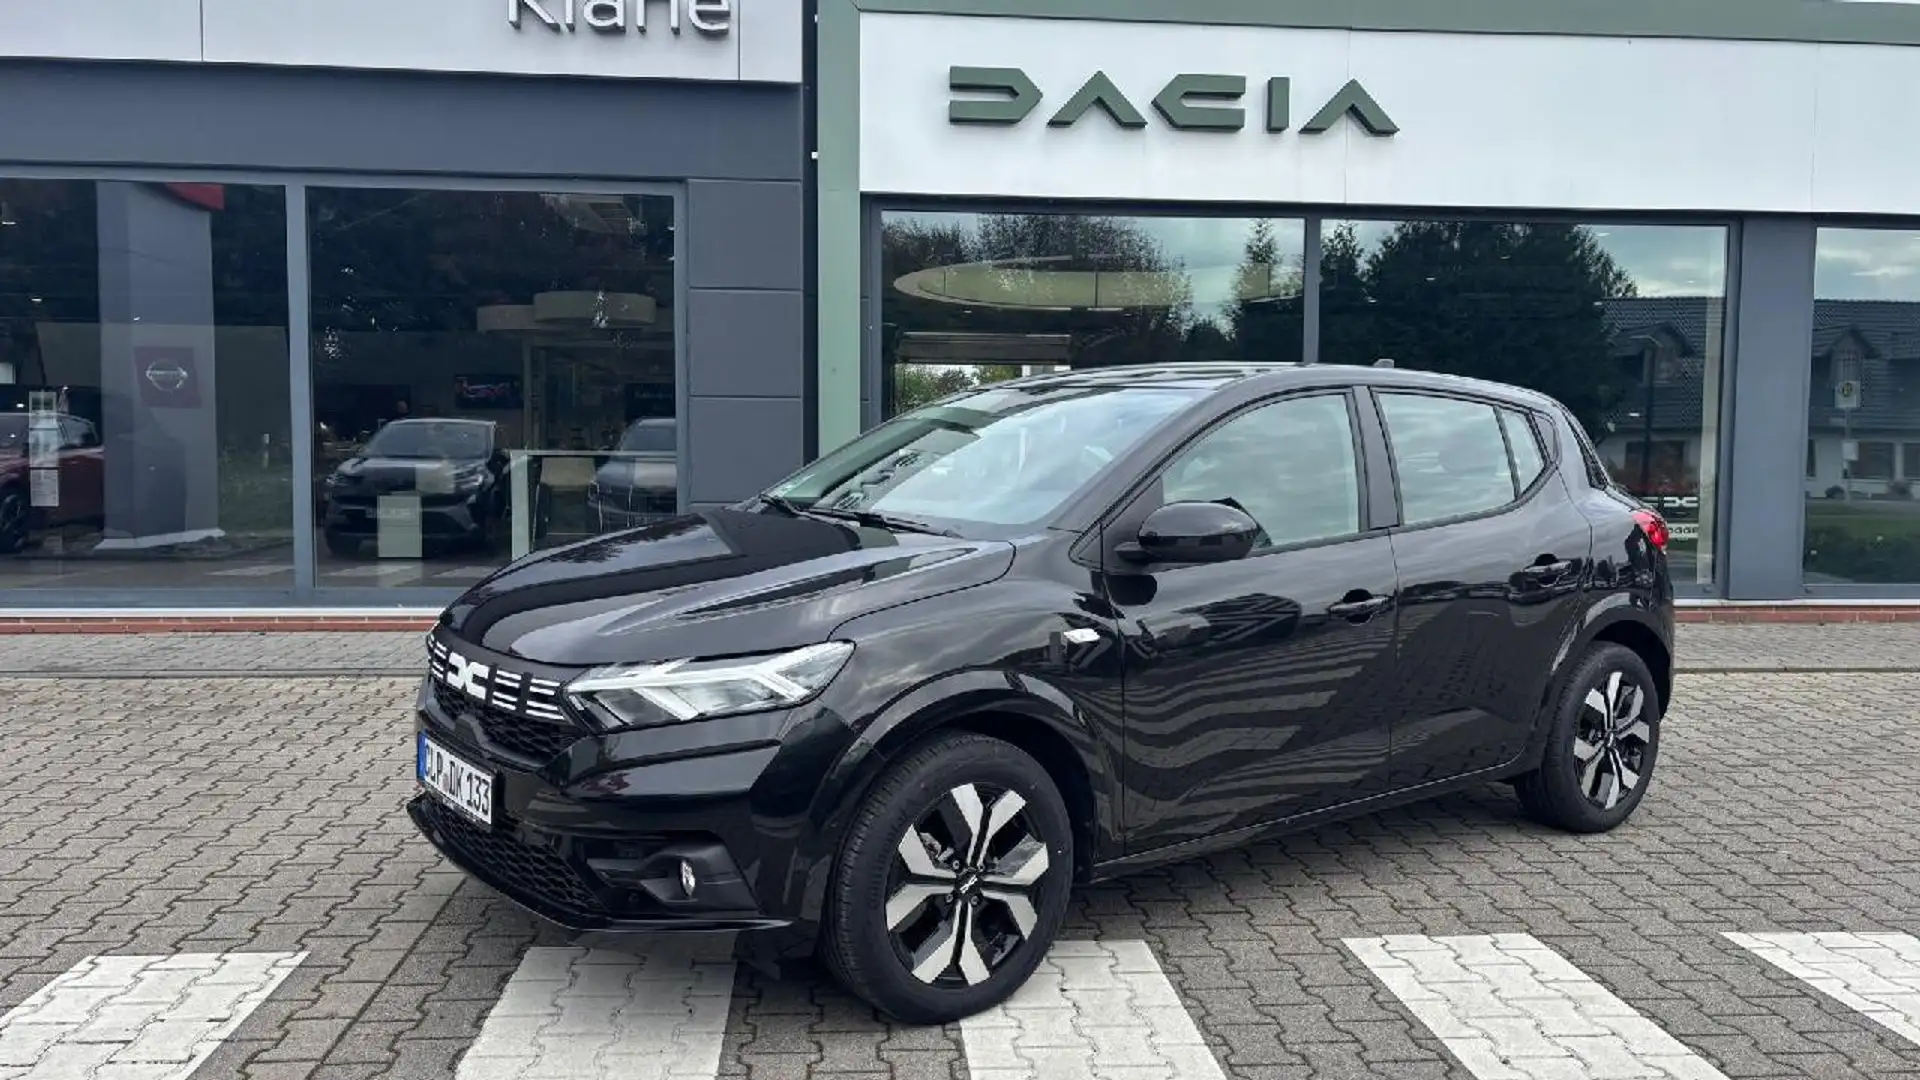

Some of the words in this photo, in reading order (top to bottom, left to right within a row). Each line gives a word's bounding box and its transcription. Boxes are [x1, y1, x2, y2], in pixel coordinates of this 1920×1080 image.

[949, 65, 1400, 135] DACIA
[449, 760, 465, 801] DK
[466, 772, 490, 815] 133
